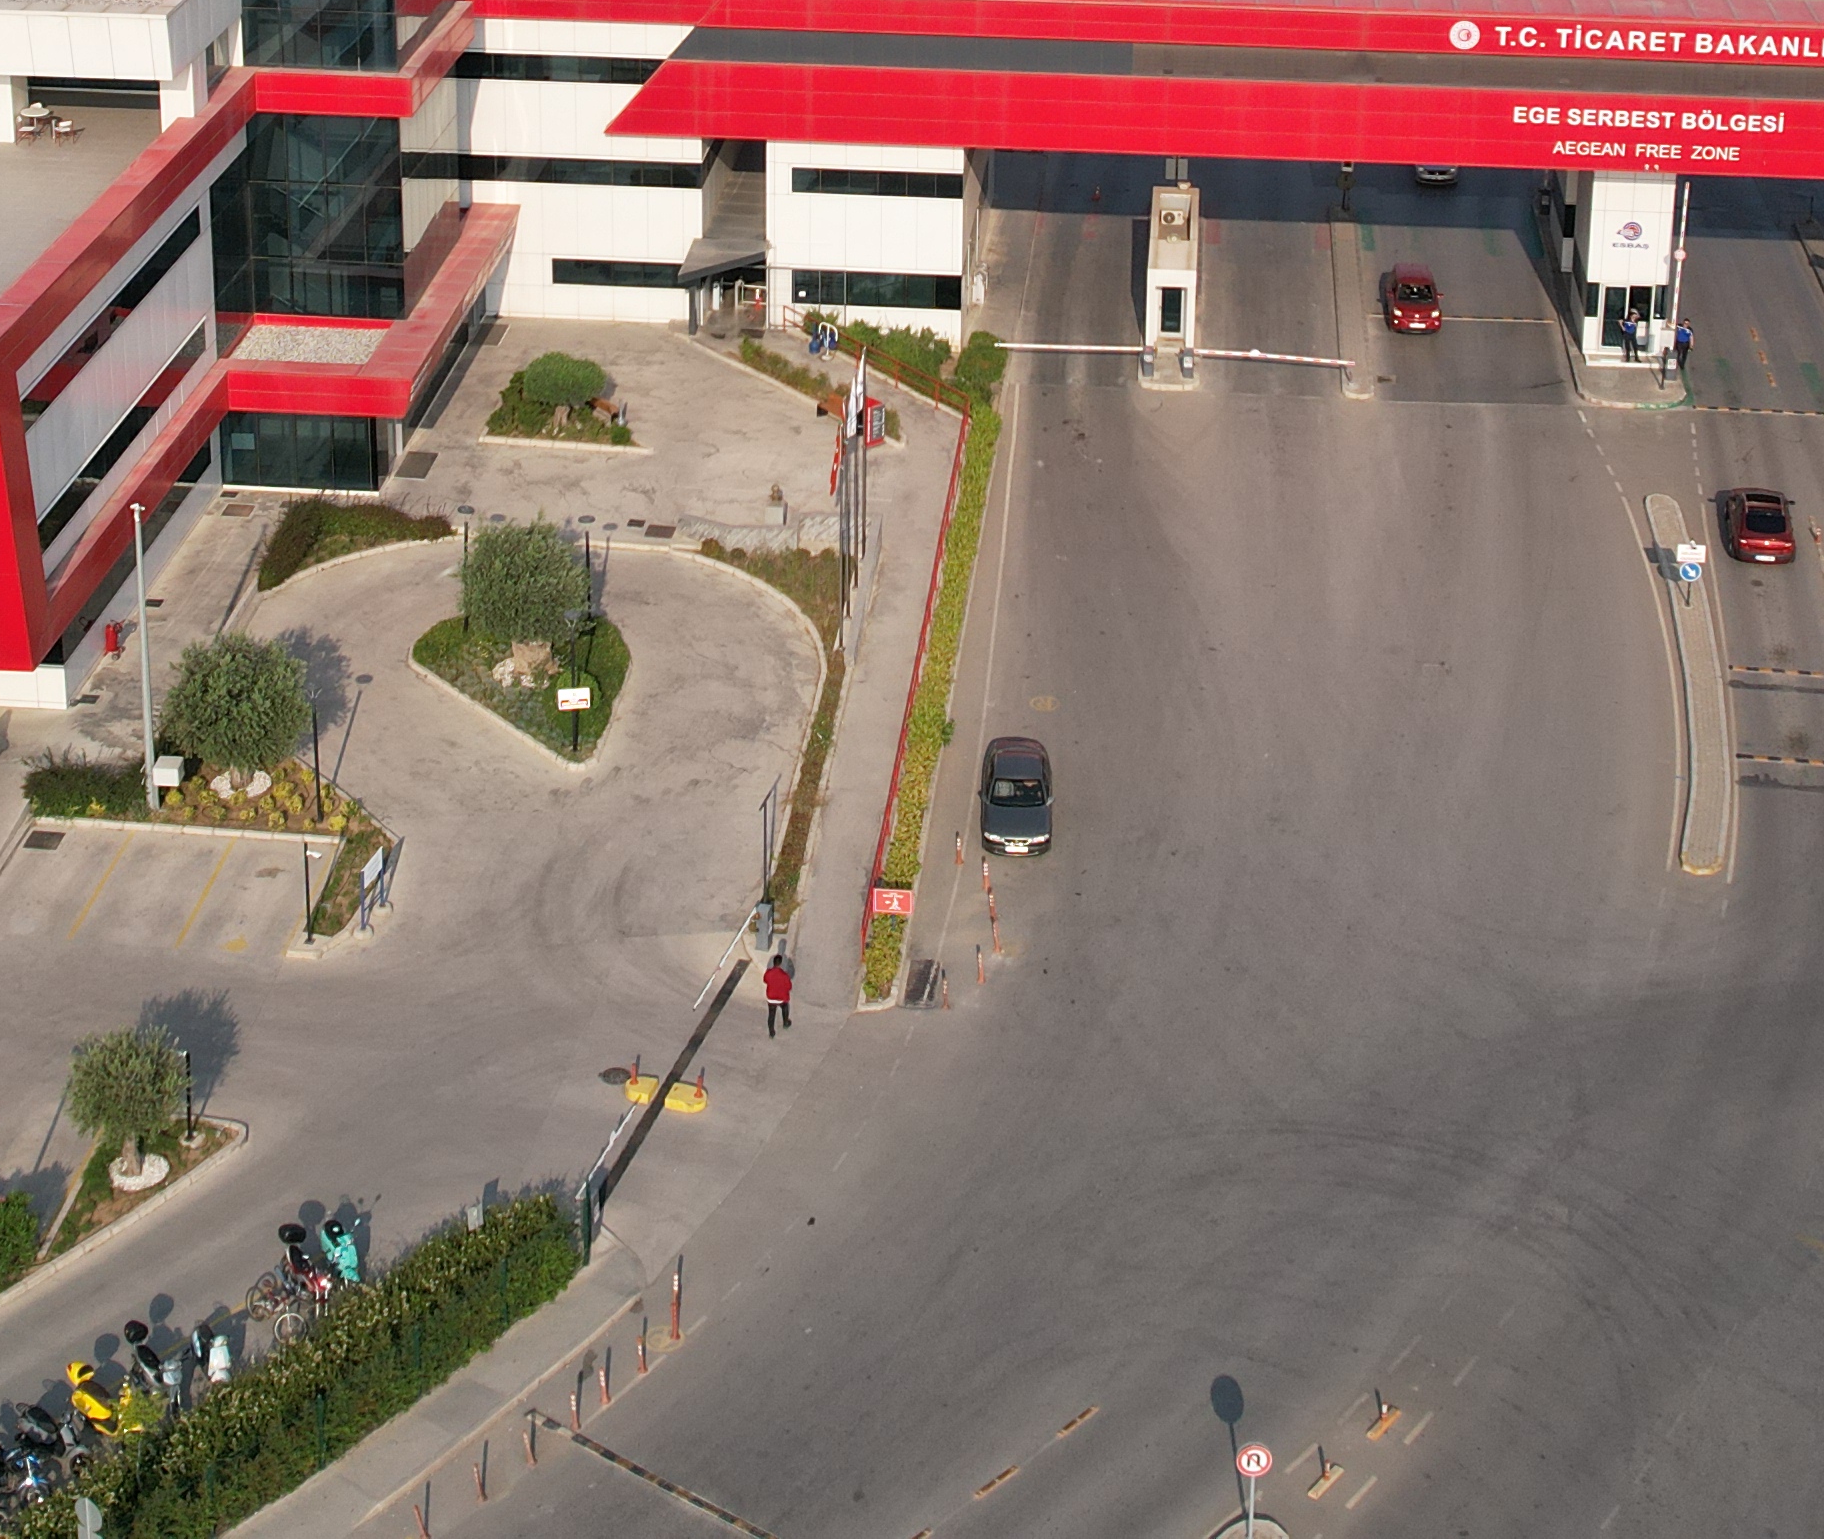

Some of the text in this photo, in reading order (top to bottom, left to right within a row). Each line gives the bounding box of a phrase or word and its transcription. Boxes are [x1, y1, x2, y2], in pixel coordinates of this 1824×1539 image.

[1495, 25, 1546, 48] T.C.
[1556, 24, 1687, 53] TİCARET
[1513, 106, 1785, 134] EGE SERBEST BÖLGESİ
[1552, 140, 1741, 161] AEGEAN FREE ZONE
